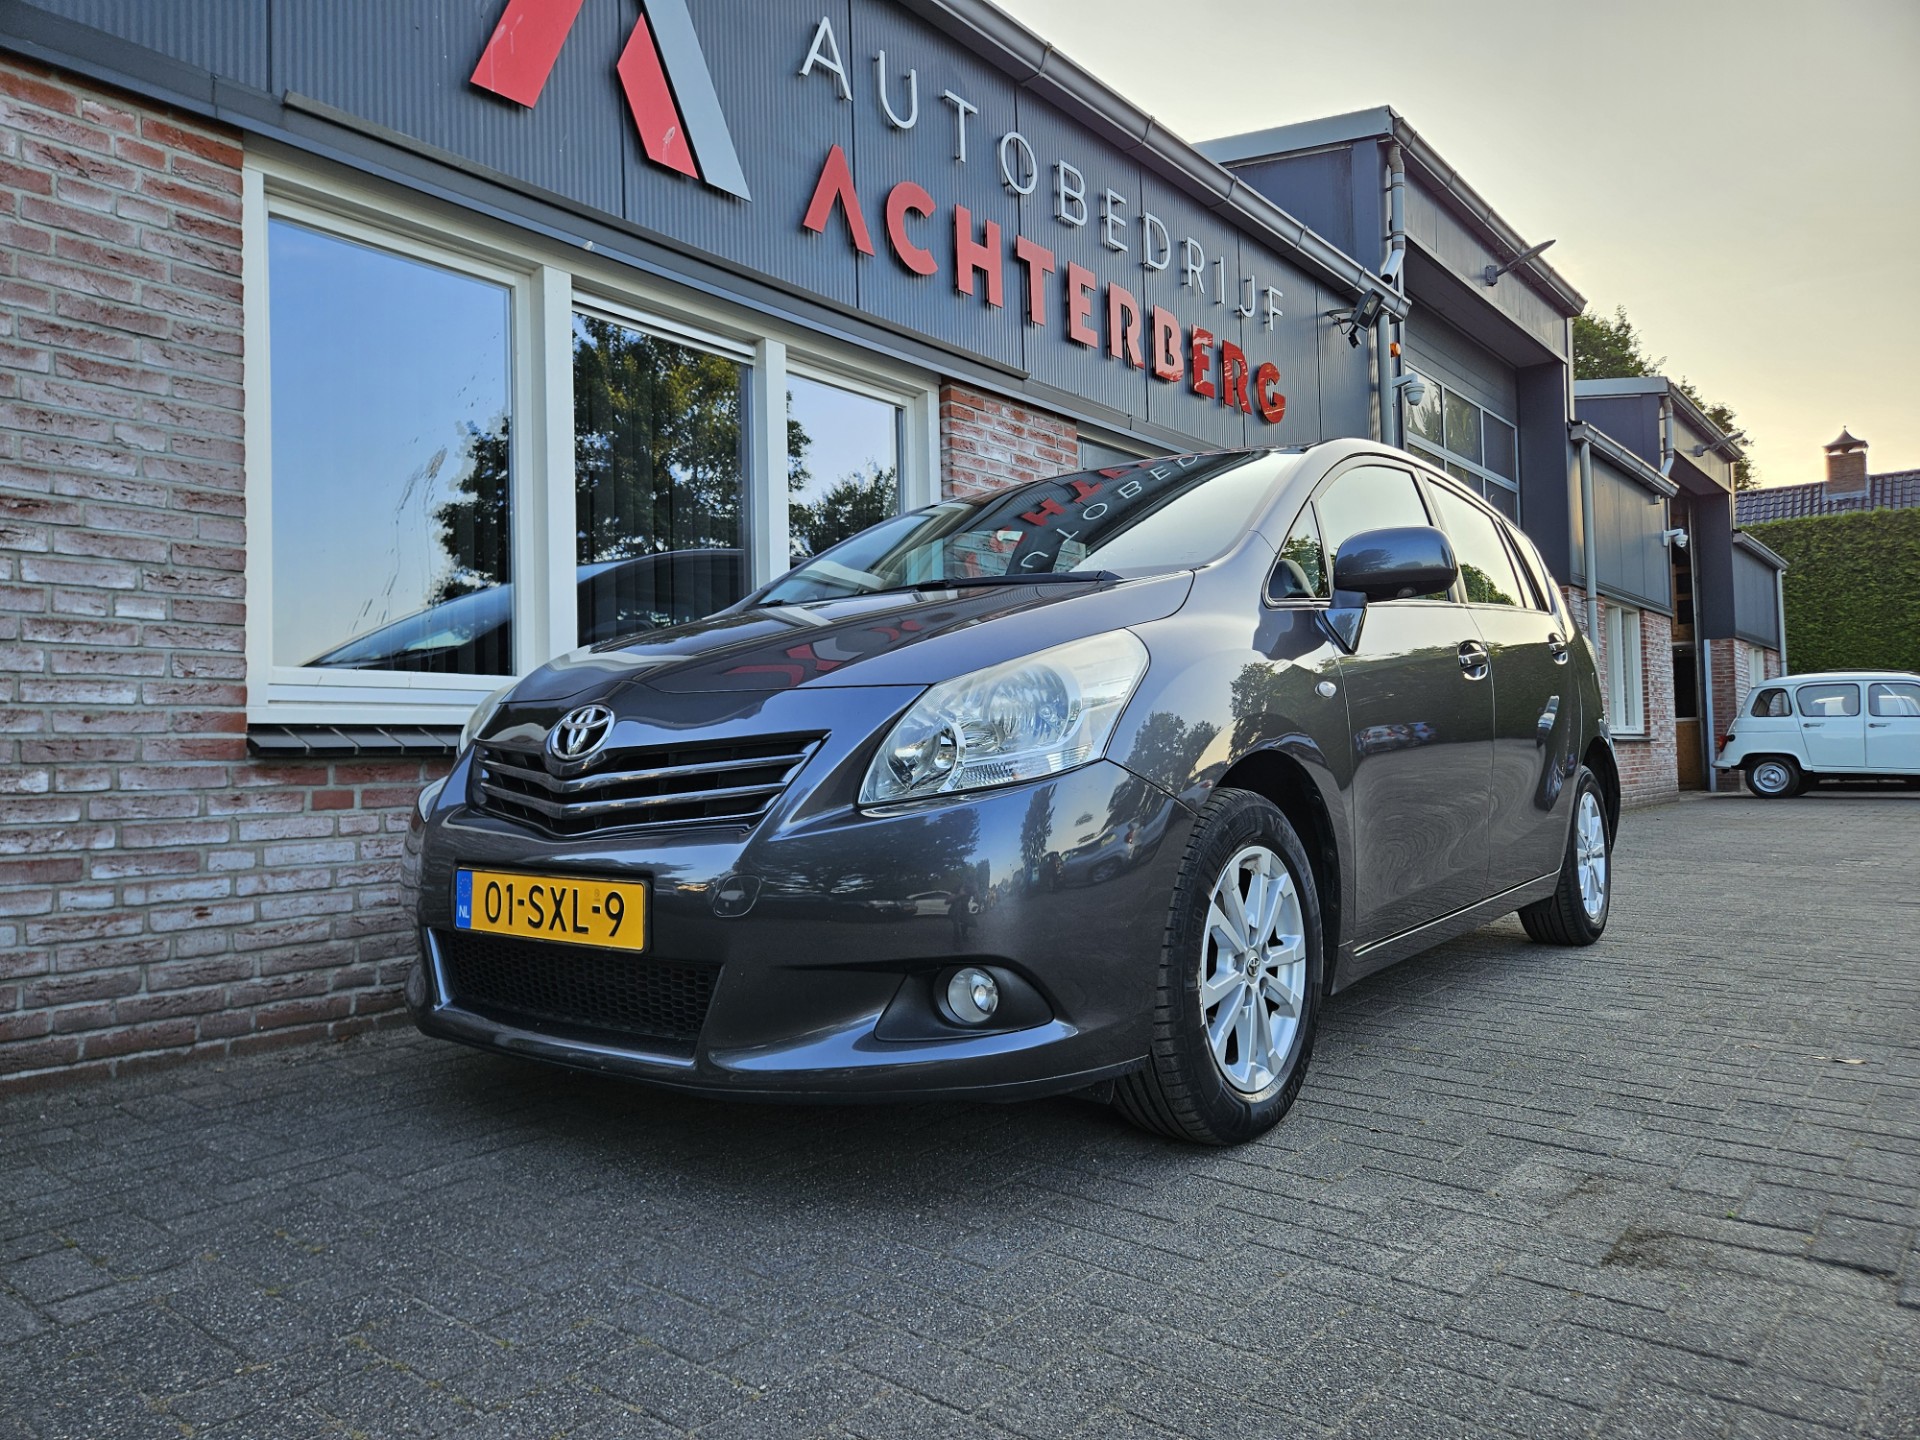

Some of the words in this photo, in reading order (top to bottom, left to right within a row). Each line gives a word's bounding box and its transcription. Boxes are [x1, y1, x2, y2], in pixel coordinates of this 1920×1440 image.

[799, 16, 1284, 331] AUTOBEDRIJF
[803, 144, 1287, 425] ACHTERBERG
[458, 904, 470, 919] NL
[484, 881, 625, 937] 01-SXL-9
